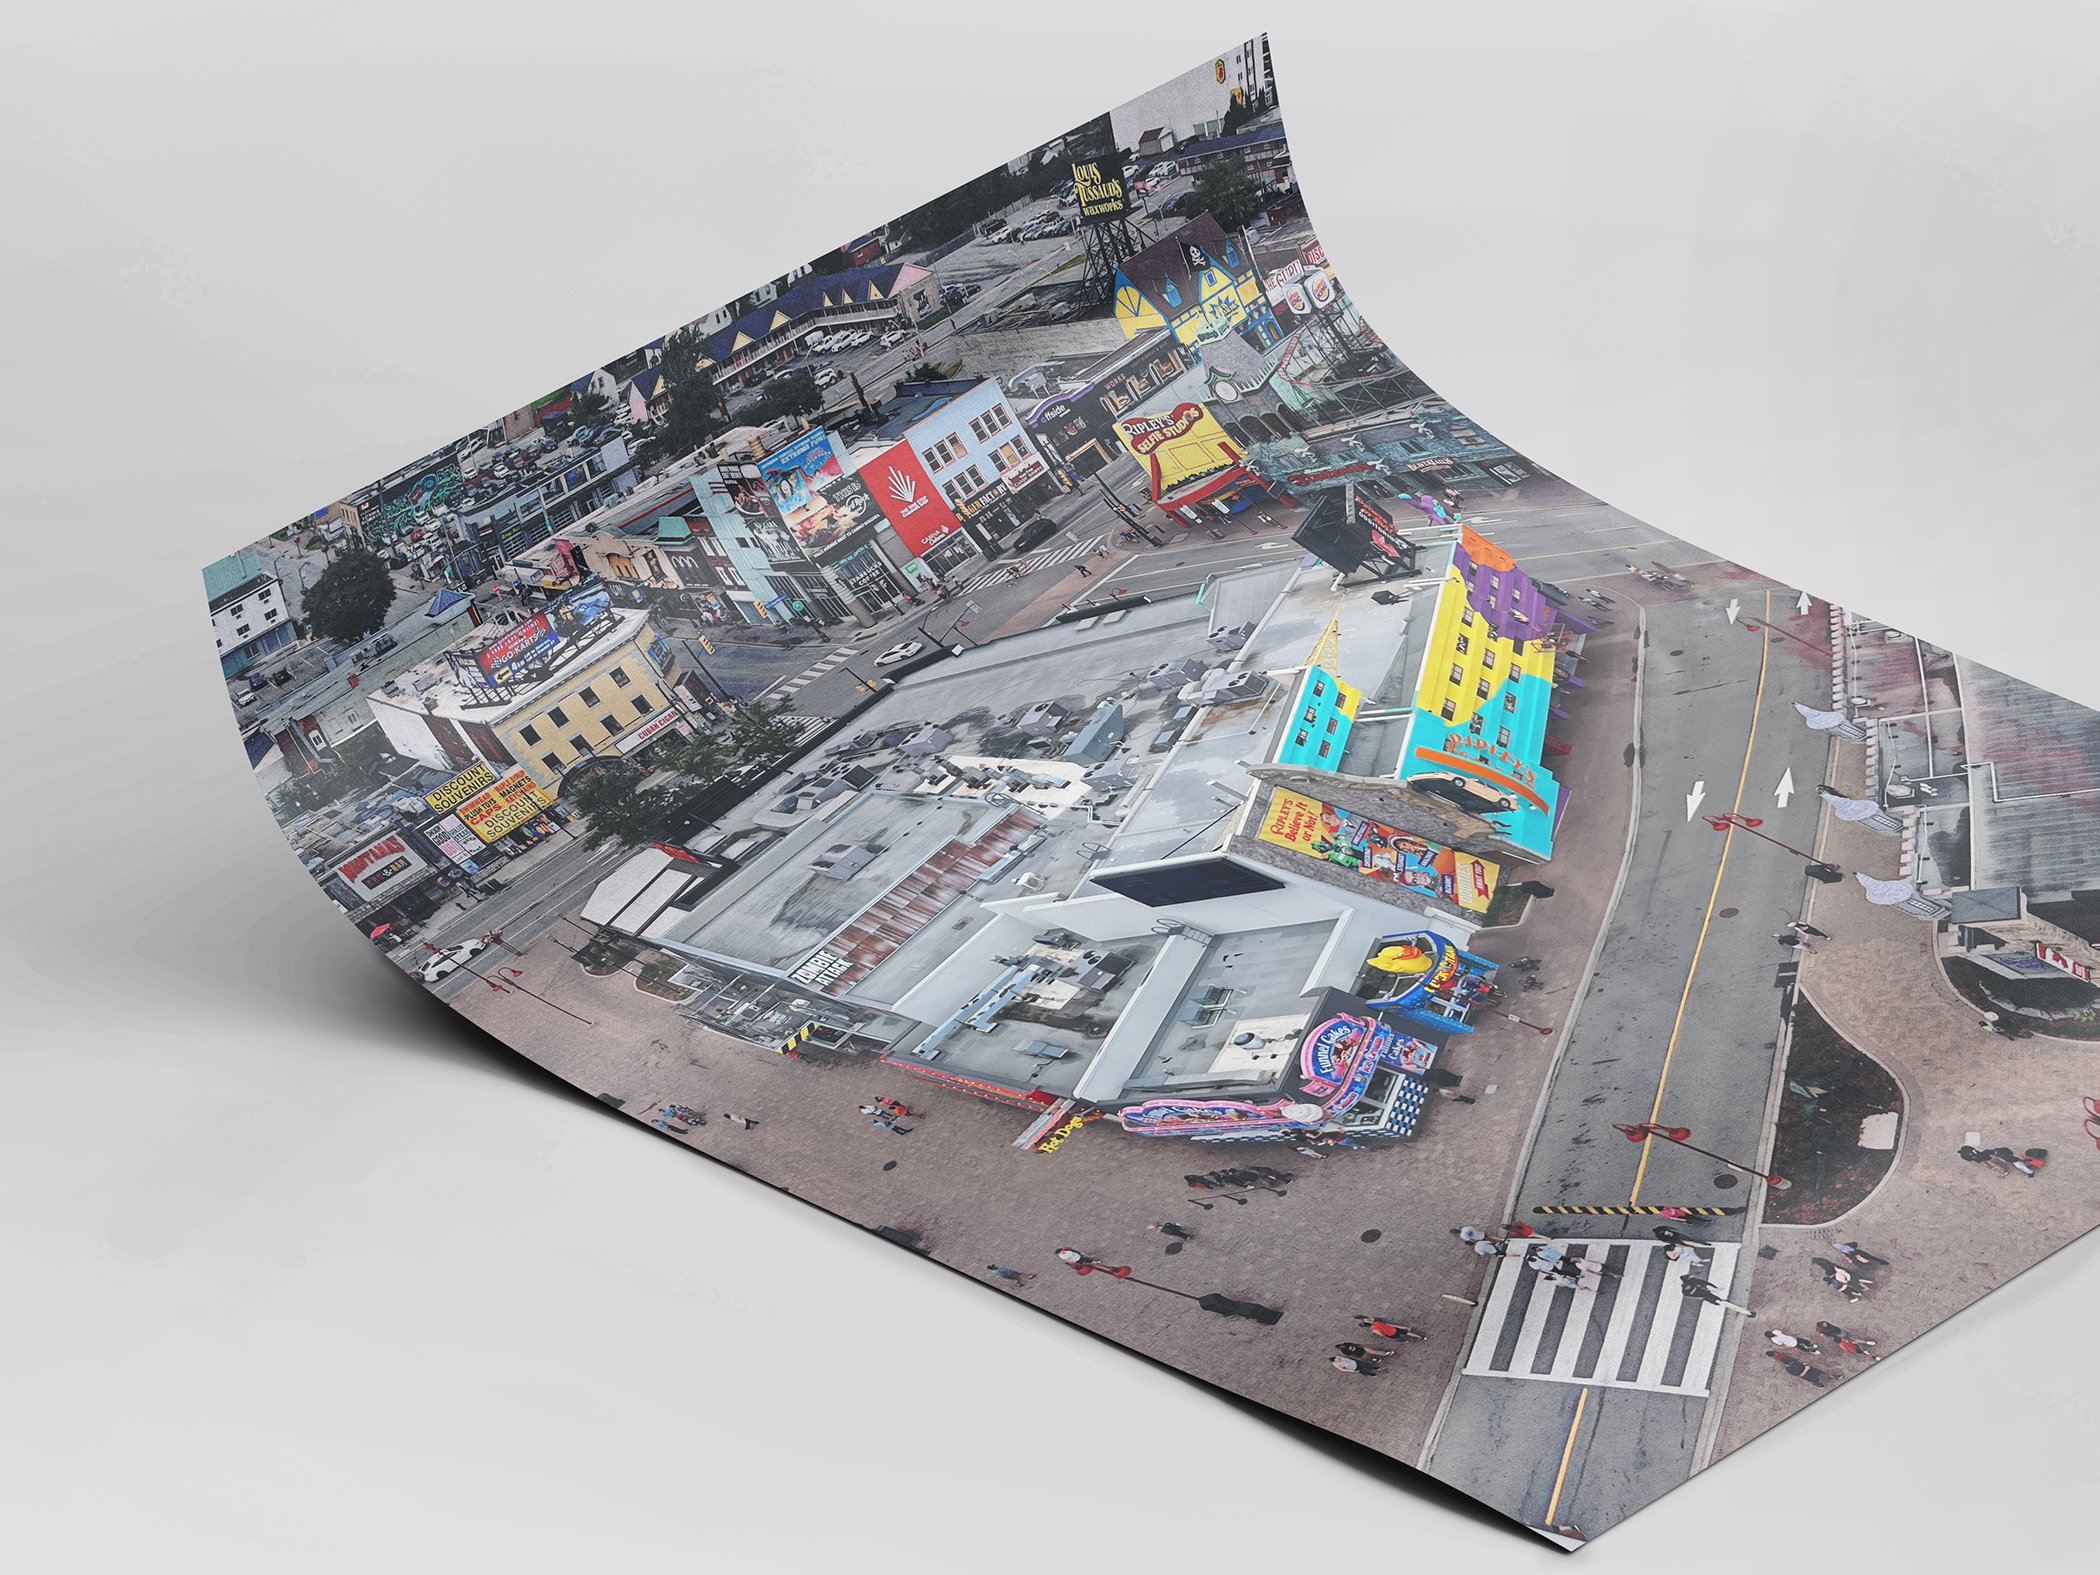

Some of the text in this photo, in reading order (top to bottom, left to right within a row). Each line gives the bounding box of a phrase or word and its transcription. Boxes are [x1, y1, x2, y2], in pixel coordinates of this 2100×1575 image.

[1121, 414, 1175, 440] RIPLEY'S
[1137, 407, 1200, 454] SELFIE STUDIOS
[849, 560, 883, 586] STARBUCKS
[638, 722, 660, 740] CUBAN
[432, 763, 487, 802] DISCOUNT
[434, 772, 495, 814] SOUVENIRS
[464, 775, 532, 821] PLUSH TOYS MAGNETS
[459, 791, 493, 816] SWIMWEAR
[470, 803, 503, 826] CAPS
[1270, 798, 1294, 836] RIPLEY'S
[1284, 801, 1308, 843] Believe It
[1302, 810, 1318, 842] or Not!
[791, 950, 839, 985] ZOMBIE
[815, 958, 854, 987] ATTACK
[1320, 1025, 1352, 1045] Cakes
[1388, 1038, 1405, 1060] Cakes
[1316, 1043, 1335, 1074] Funnel
[1039, 1114, 1084, 1154] Hot Dogs
